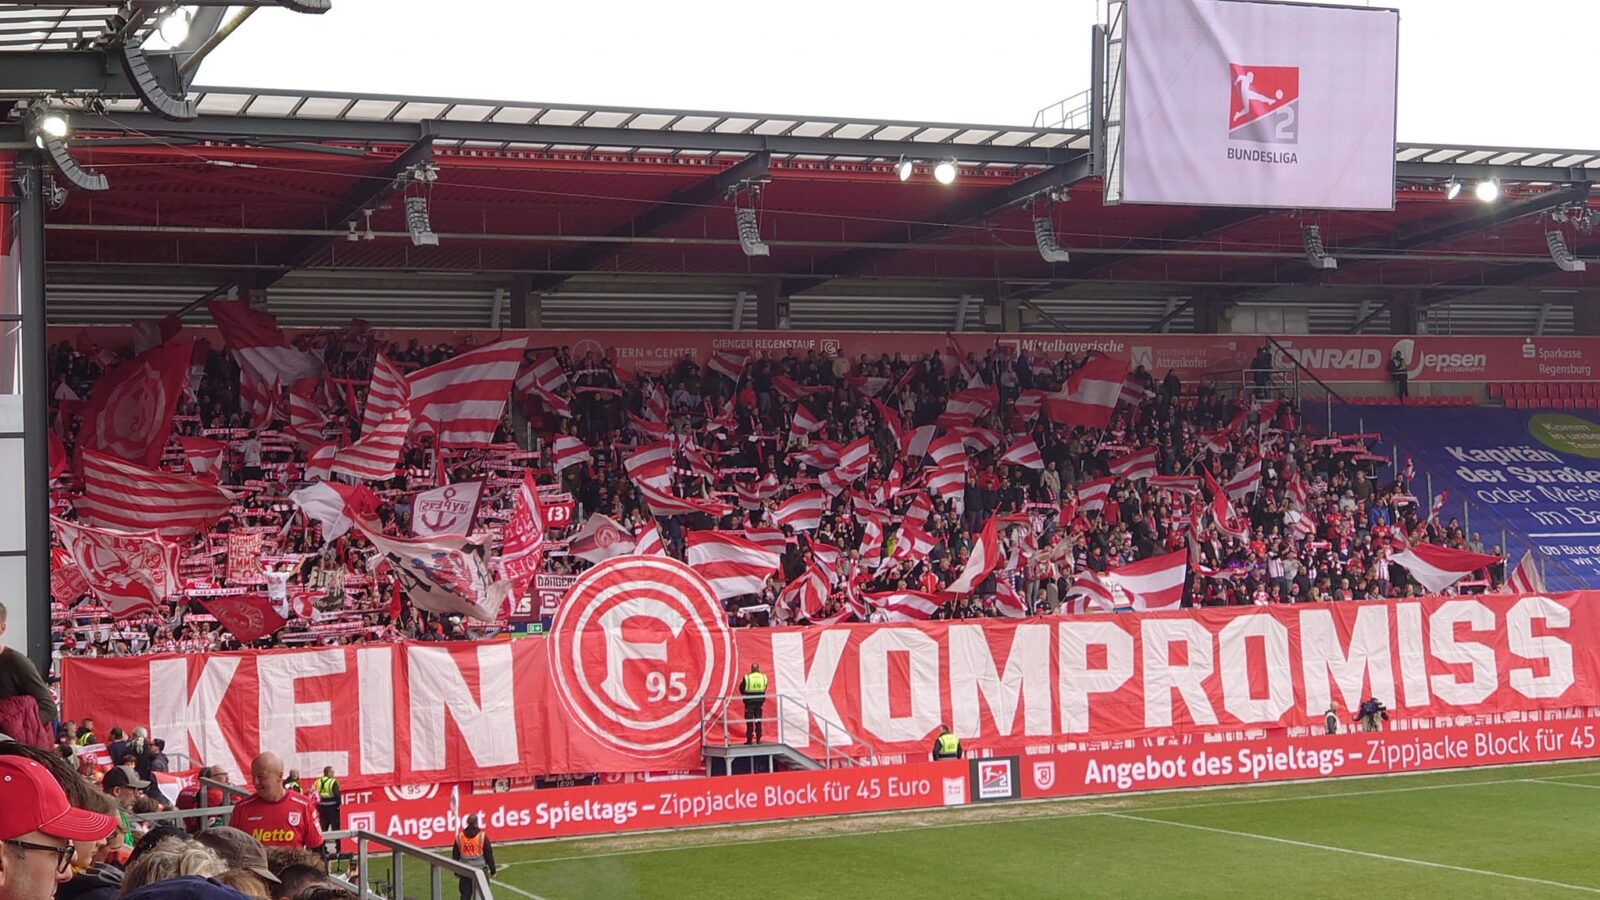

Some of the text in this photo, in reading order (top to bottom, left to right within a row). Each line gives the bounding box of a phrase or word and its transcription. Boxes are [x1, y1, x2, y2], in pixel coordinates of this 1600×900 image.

[1275, 105, 1296, 140] 2
[1227, 147, 1298, 164] BUNDESLIGA
[712, 339, 815, 349] GIENGER REGENSTAUF
[613, 347, 644, 359] TERN
[654, 347, 699, 359] CENTER
[1538, 347, 1582, 360] Sparkasse
[1538, 363, 1592, 377] Regensburg
[1444, 446, 1564, 465] Kapitän
[1456, 466, 1509, 483] der
[1476, 486, 1538, 504] oder
[1524, 507, 1572, 525] im
[1560, 545, 1590, 555] Bus
[149, 595, 1575, 786] KEIN KOMPROMISS
[645, 671, 688, 702] 95
[1084, 753, 1187, 789] Angebot
[1191, 750, 1233, 776] des
[1238, 744, 1345, 781] Spieltags
[1366, 736, 1469, 769] Zippjacke
[1474, 732, 1530, 757] Block
[1535, 728, 1564, 751] für
[1569, 726, 1596, 749] 45
[406, 784, 421, 795] 95
[489, 805, 538, 829] des
[542, 798, 638, 829] Spieltags
[658, 786, 758, 819] Zippjacke
[764, 783, 818, 808] Block
[822, 779, 852, 802] für
[855, 778, 881, 800] 45
[888, 775, 931, 798] Euro
[252, 828, 295, 842] Netto
